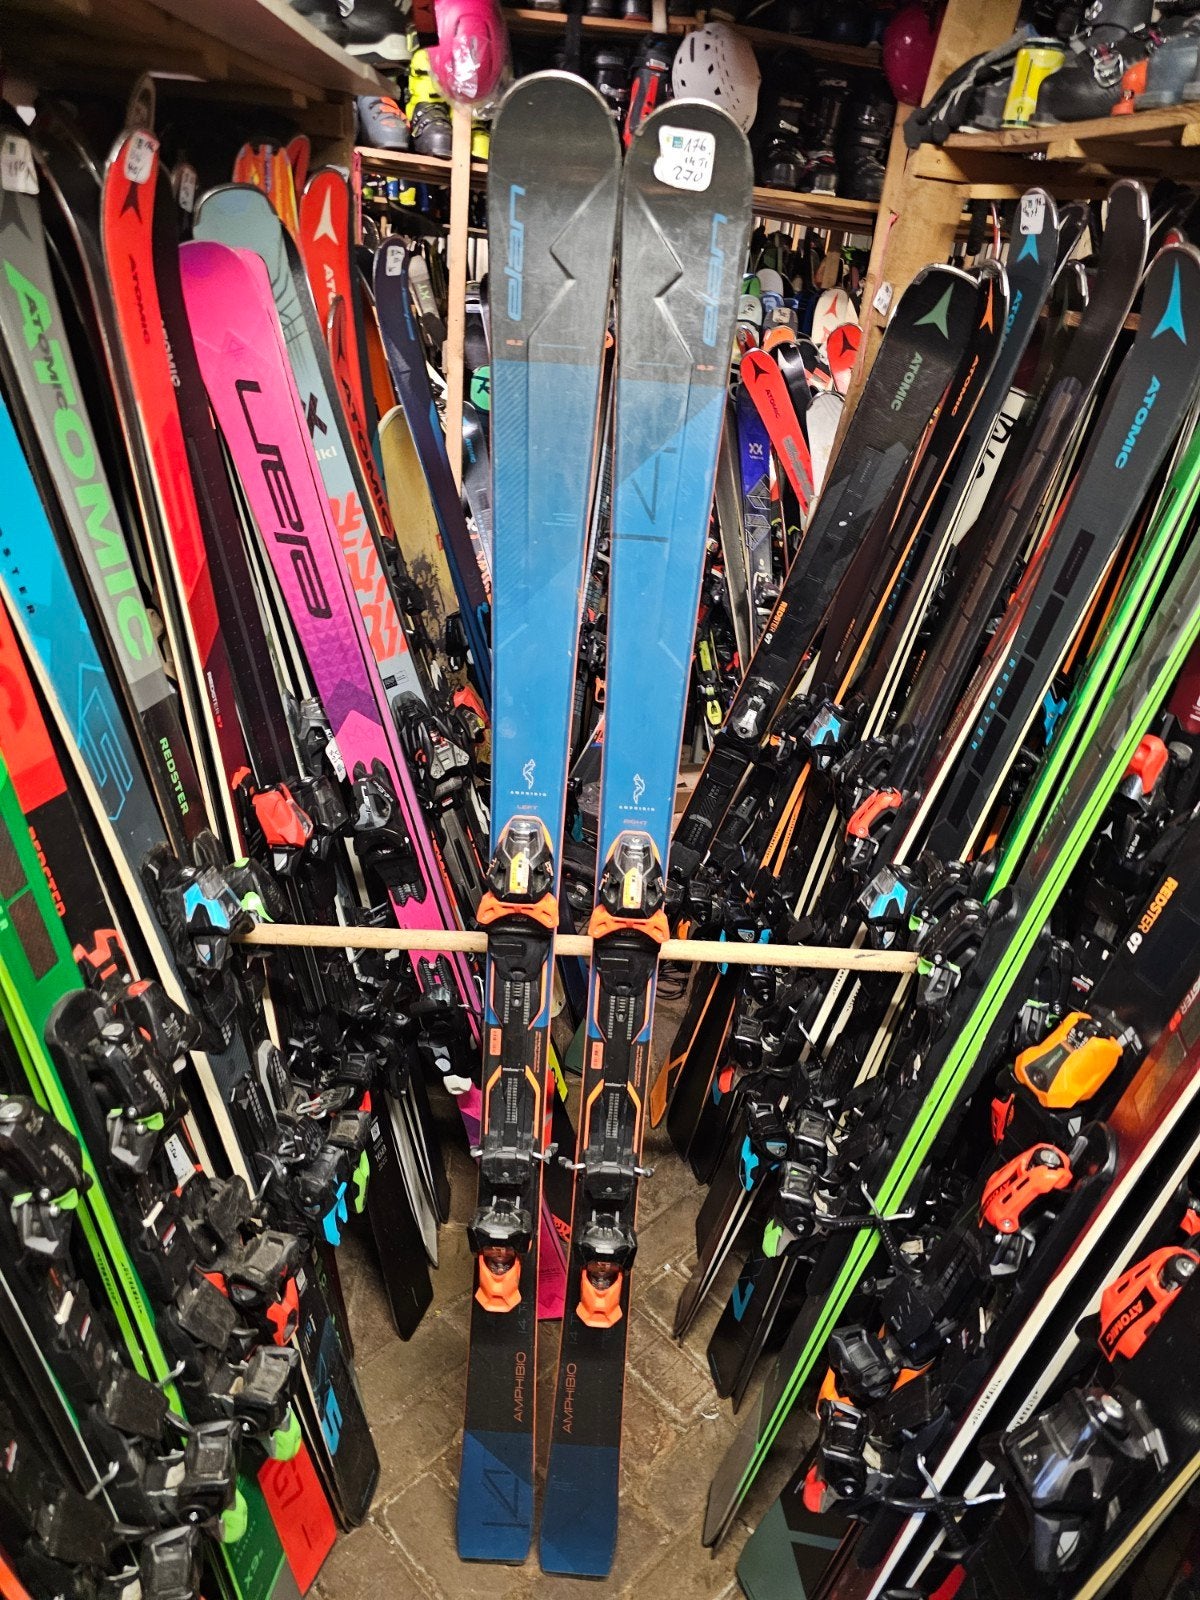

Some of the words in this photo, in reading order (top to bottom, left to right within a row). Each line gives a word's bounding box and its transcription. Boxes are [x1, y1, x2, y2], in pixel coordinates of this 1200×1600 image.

[503, 184, 526, 322] elan
[702, 213, 728, 348] elan
[160, 319, 181, 389] OMIC
[890, 351, 925, 412] ATOMIC
[951, 354, 979, 417] ATOMIC
[341, 377, 394, 534] ATOMIC
[1115, 374, 1161, 469] ATOMIC
[3, 259, 153, 662] ATOMIC
[235, 377, 334, 621] elan
[3, 547, 35, 614] STER
[771, 600, 789, 633] REDSTER
[159, 736, 191, 816] REDSTER
[516, 803, 539, 811] LEFT
[1138, 875, 1179, 934] REDSTER
[1180, 974, 1200, 1015] STER
[1105, 1299, 1144, 1346] ATOMIC
[513, 1351, 527, 1422] AMPHIBIO
[562, 1362, 577, 1434] AMPHIBIO
